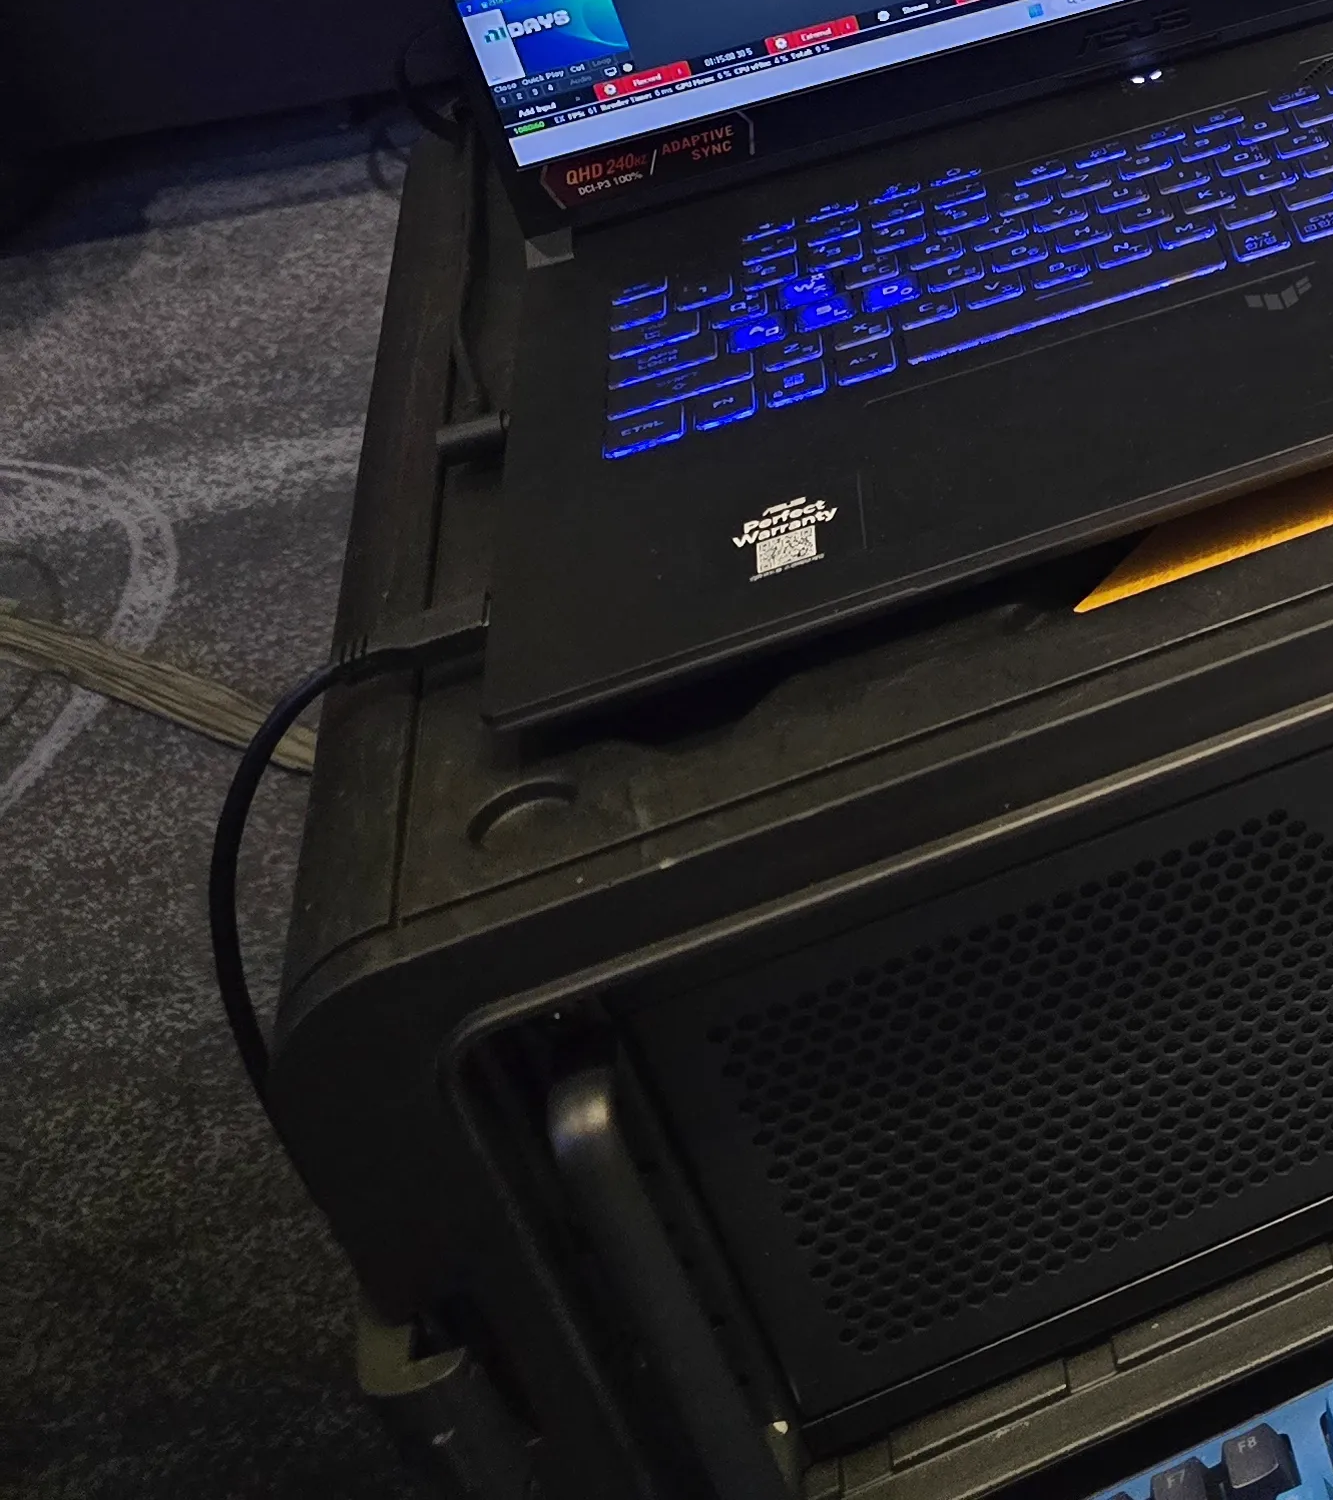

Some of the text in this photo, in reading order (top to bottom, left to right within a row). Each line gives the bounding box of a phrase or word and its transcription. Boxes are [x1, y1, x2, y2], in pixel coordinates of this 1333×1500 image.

[508, 10, 570, 38] DAYS
[546, 70, 564, 80] Play
[570, 64, 585, 72] Cut
[633, 74, 662, 87] Record
[519, 108, 536, 117] Add
[600, 99, 628, 111] Render
[661, 125, 734, 155] ADAPTIVE
[691, 140, 732, 161] SYNC
[566, 160, 602, 185] QHD
[578, 170, 643, 196] DCI-P3 100%
[732, 506, 838, 548] Warranty
[743, 500, 826, 534] Perfect
[1237, 1434, 1258, 1455] F8
[1167, 1468, 1186, 1489] F7
